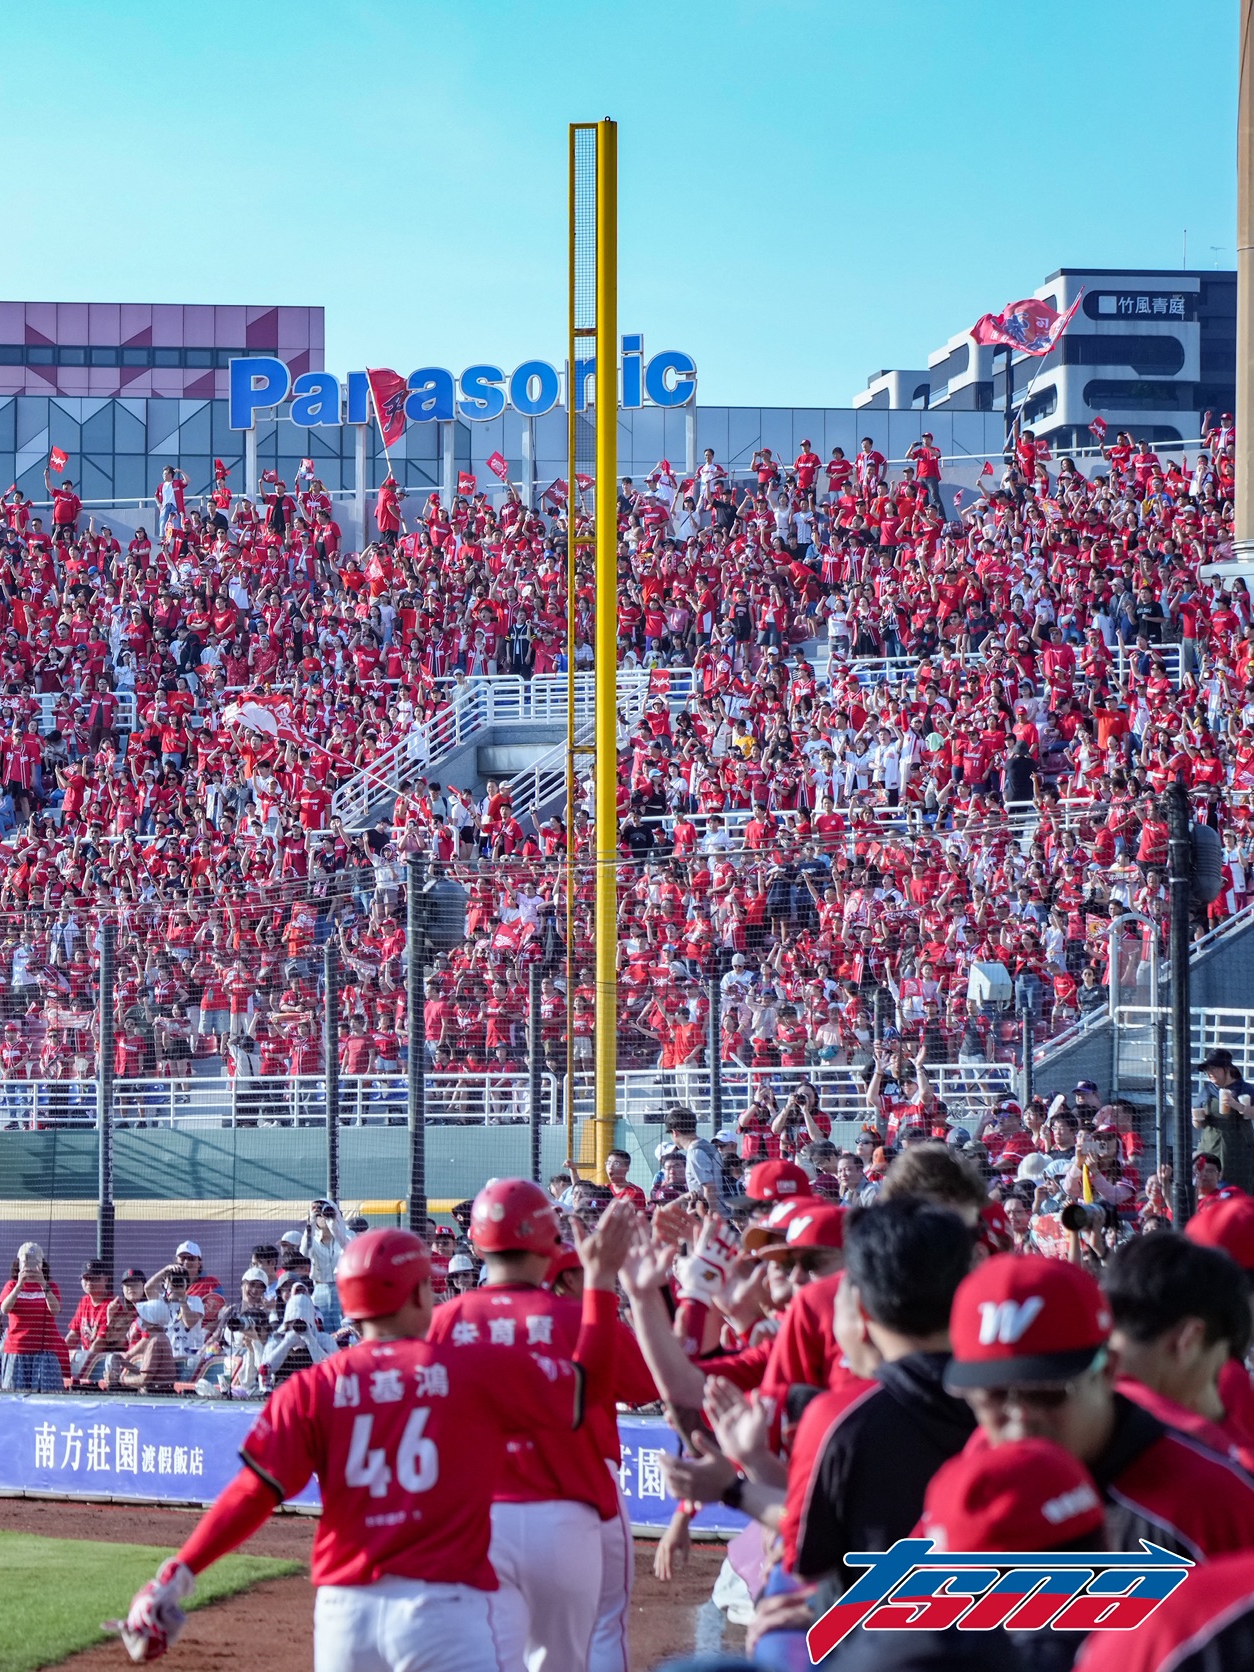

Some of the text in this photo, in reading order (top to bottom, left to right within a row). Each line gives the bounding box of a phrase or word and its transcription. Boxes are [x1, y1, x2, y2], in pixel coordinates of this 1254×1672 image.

[1118, 296, 1186, 315] 竹風青庭
[141, 1444, 204, 1476] 渡假飯店
[344, 1406, 439, 1498] 46
